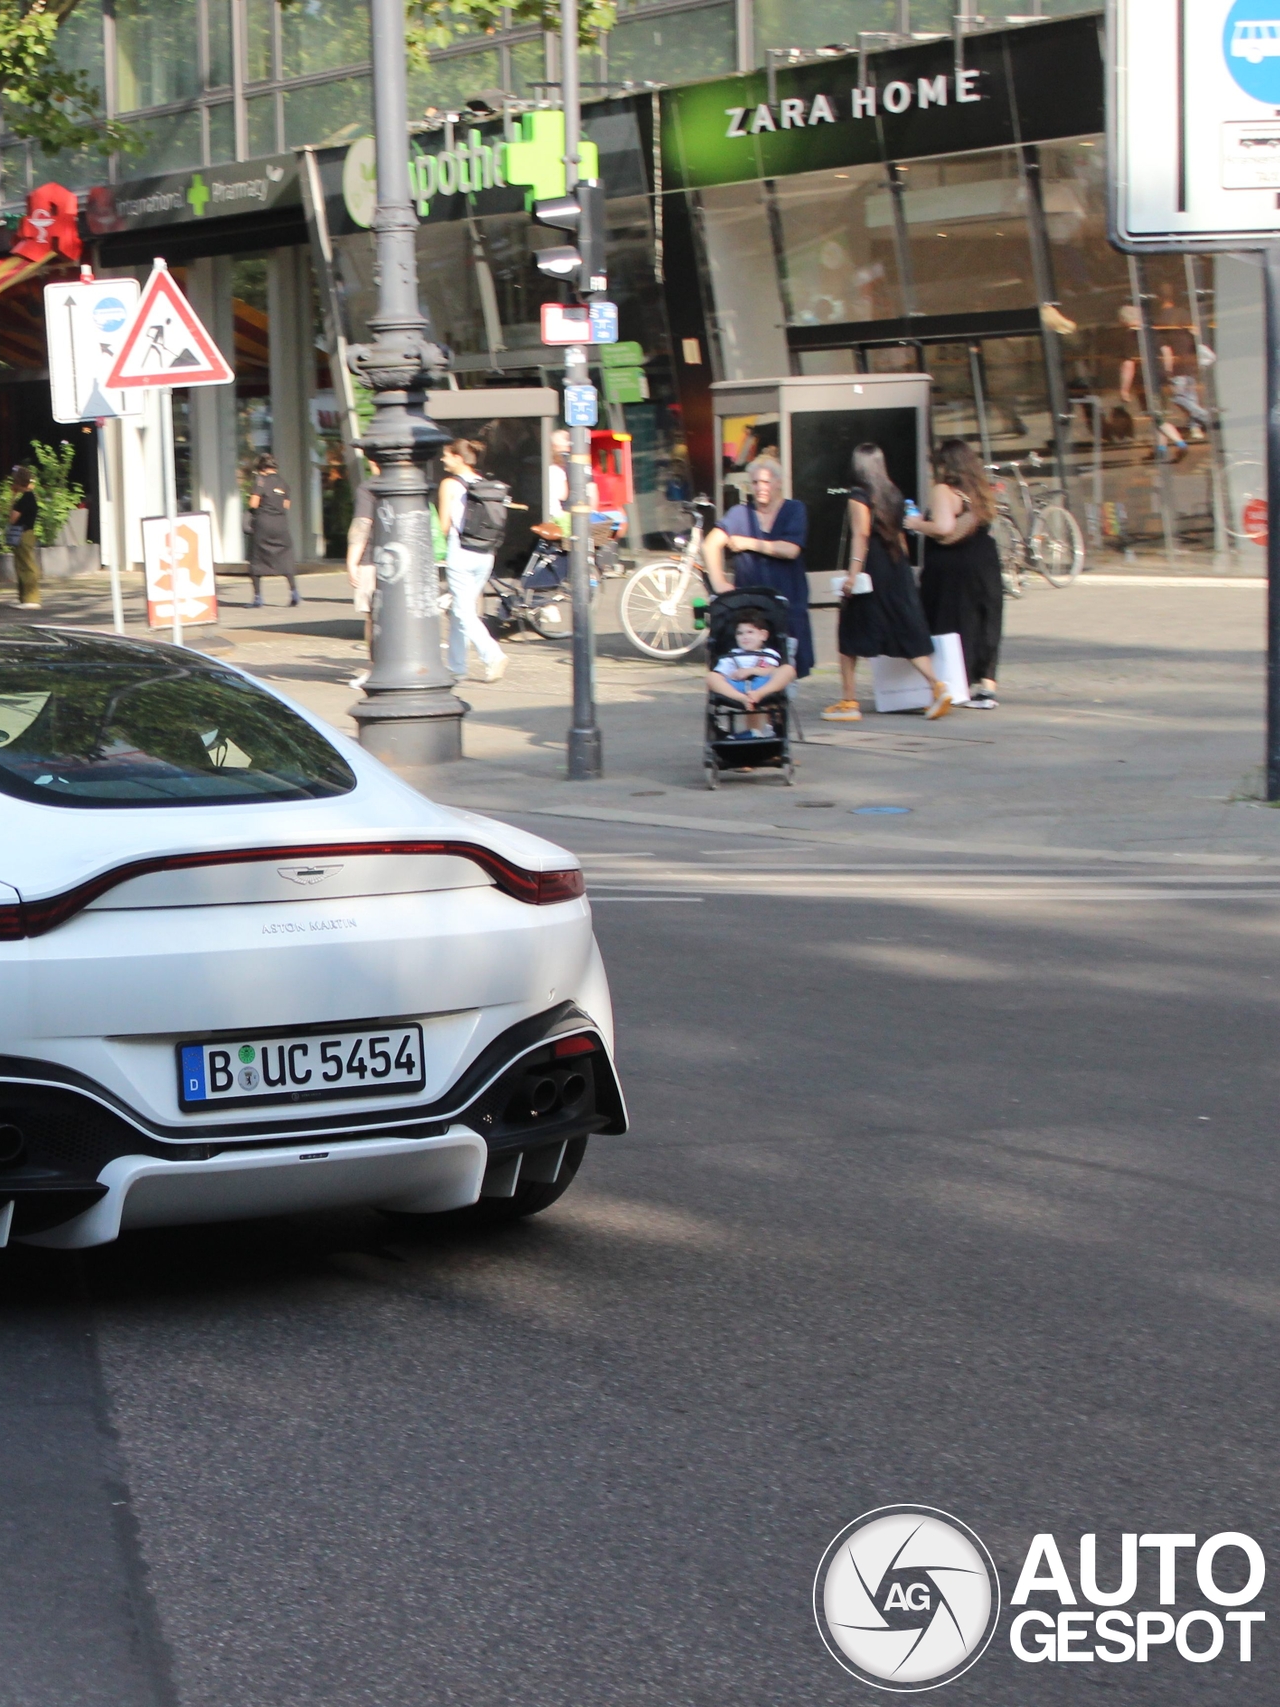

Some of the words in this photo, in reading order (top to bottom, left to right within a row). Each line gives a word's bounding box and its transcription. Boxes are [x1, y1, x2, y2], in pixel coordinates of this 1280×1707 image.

[724, 94, 835, 138] ZARA
[851, 69, 981, 119] HOME
[212, 178, 267, 203] Pharmacy
[262, 922, 305, 934] ASTON
[309, 918, 358, 932] MARTIN
[209, 1050, 234, 1093] B
[261, 1043, 313, 1087] UC
[320, 1034, 416, 1082] 5454
[189, 1079, 199, 1092] D
